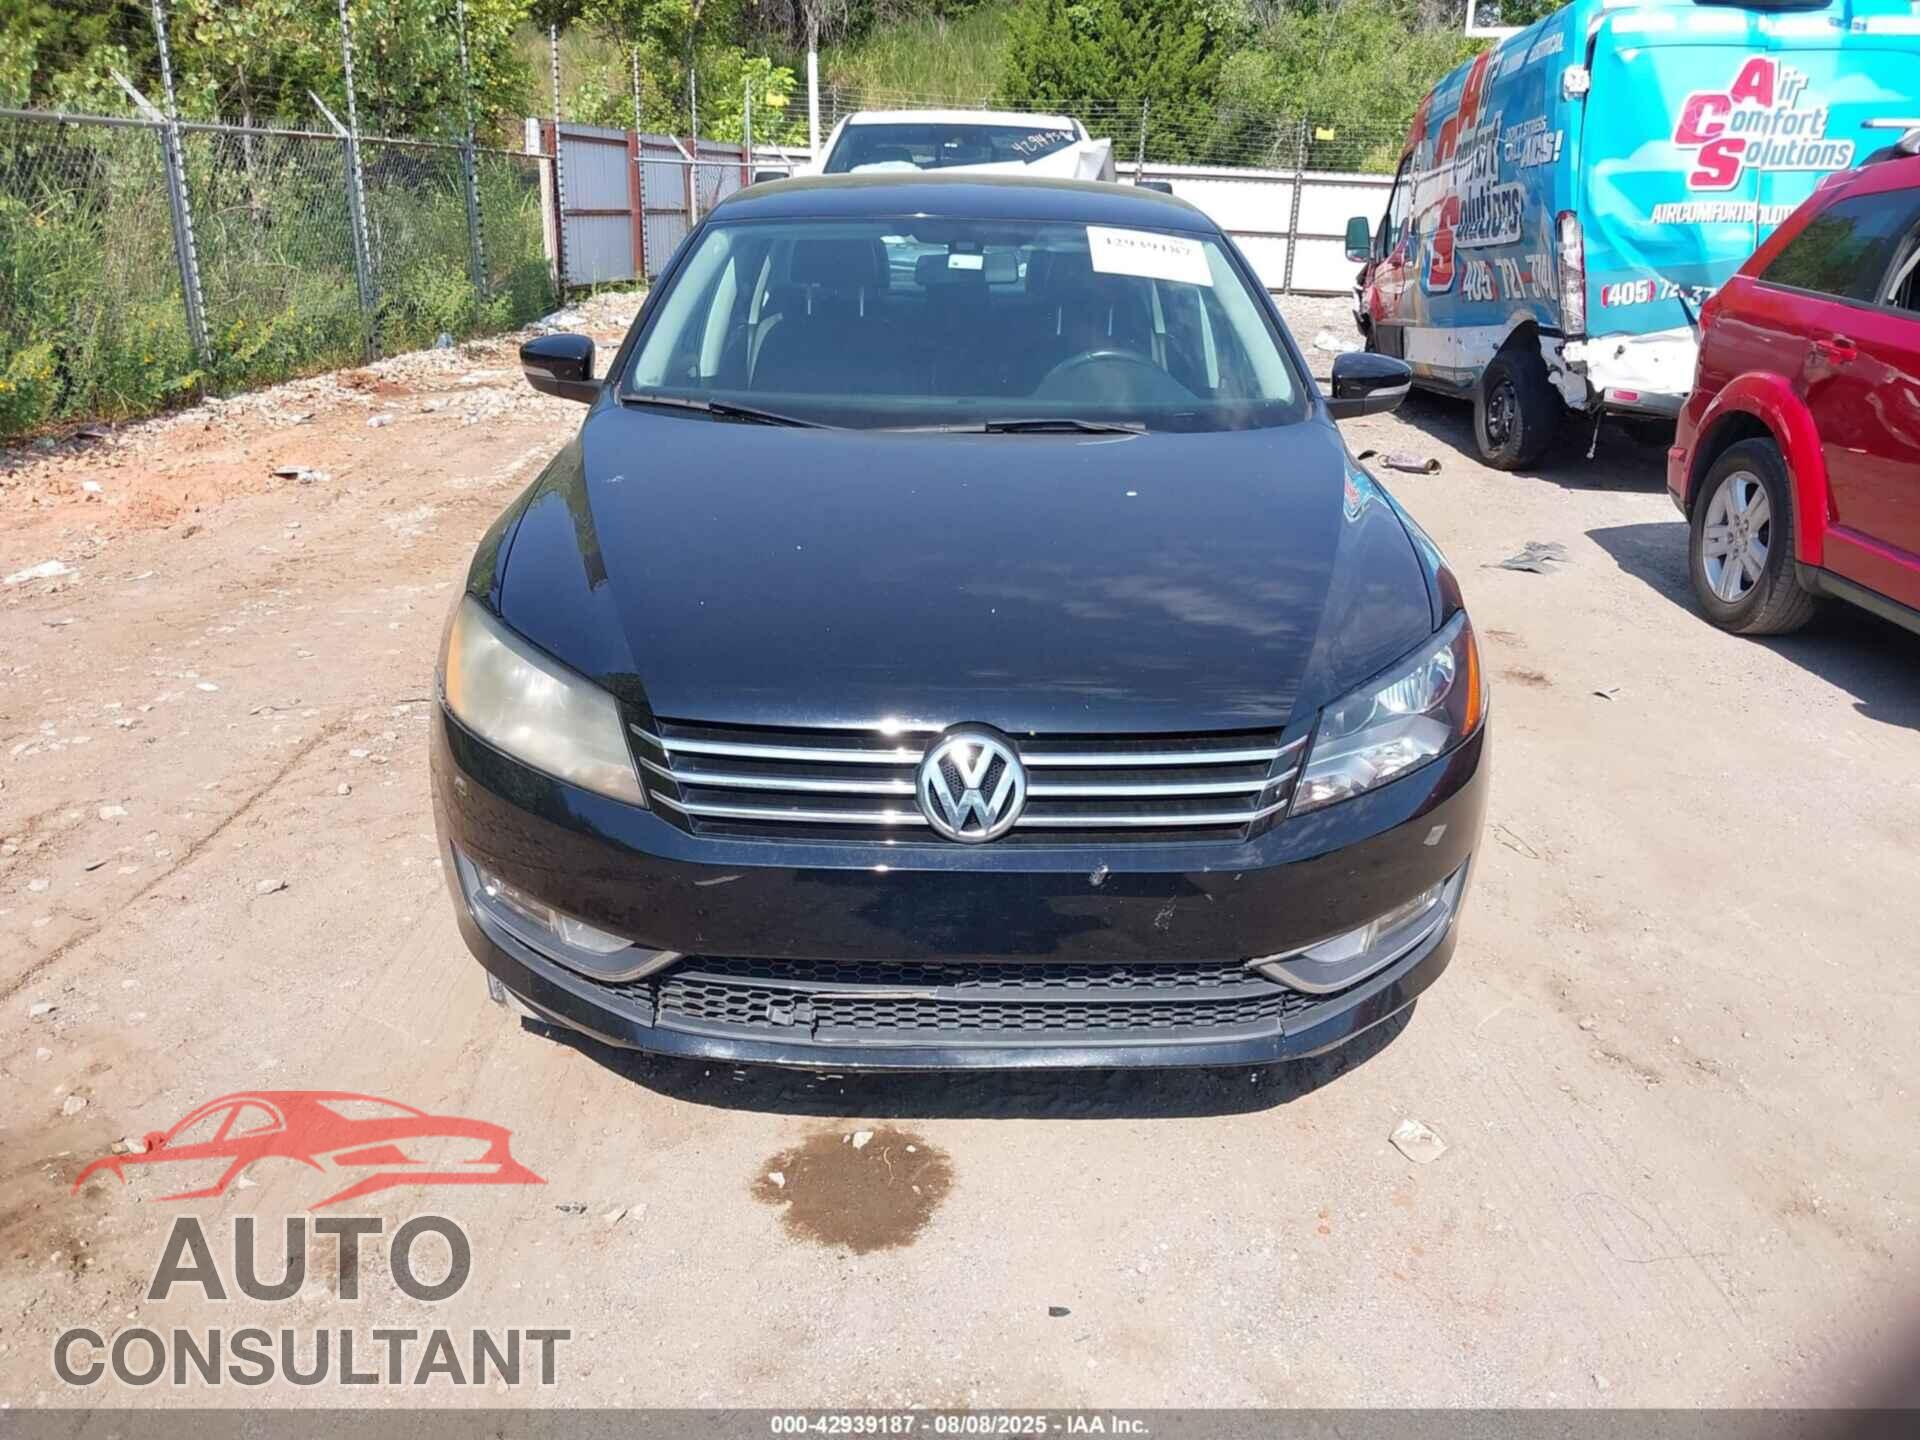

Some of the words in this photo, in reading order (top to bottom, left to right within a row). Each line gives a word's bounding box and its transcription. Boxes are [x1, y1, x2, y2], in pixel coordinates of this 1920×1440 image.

[1730, 58, 1801, 107] Air
[1674, 94, 1823, 144] Comfort
[1690, 138, 1851, 186] Solutions
[1601, 279, 1656, 308] (405)
